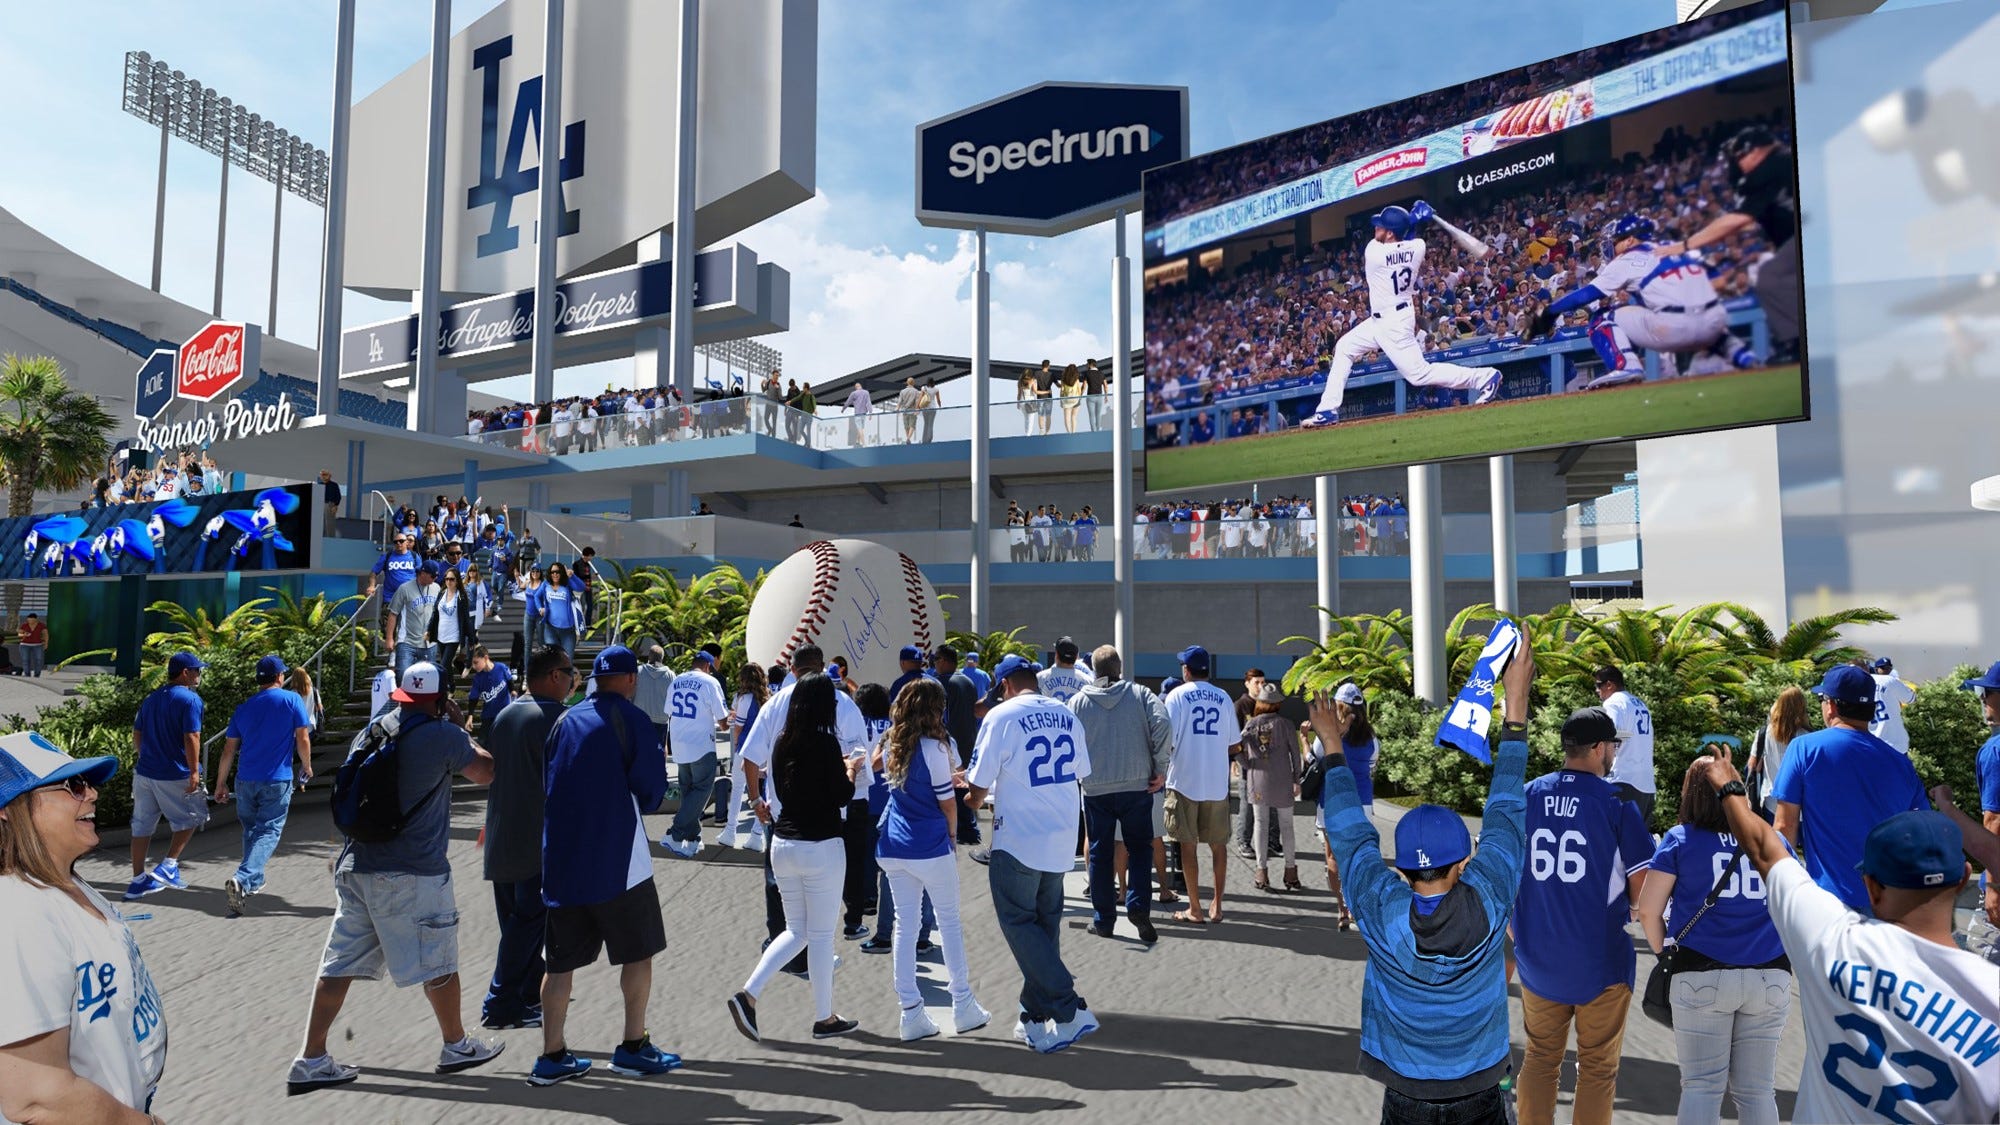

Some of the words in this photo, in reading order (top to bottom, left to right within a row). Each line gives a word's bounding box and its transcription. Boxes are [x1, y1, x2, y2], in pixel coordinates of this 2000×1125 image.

[949, 123, 1150, 184] Spectrum
[1357, 157, 1396, 184] FARMER
[1395, 151, 1425, 167] JOHN
[1474, 152, 1555, 186] CAESARS.COM
[1386, 251, 1415, 266] MUNCY
[1390, 267, 1412, 295] 13
[450, 308, 534, 350] Angeles
[368, 332, 384, 363] LA
[143, 371, 165, 398] ACME
[133, 412, 219, 453] Sponsor
[223, 392, 294, 441] Porch
[388, 561, 414, 571] SOCAL
[1044, 676, 1085, 691] GONZALE
[1184, 690, 1224, 706] KERSHAW
[1018, 711, 1074, 735] KERSHAW
[1191, 706, 1220, 736] 22
[1635, 709, 1650, 735] 27
[1025, 734, 1077, 788] 22
[1544, 795, 1580, 818] PUIG
[1717, 832, 1739, 848] PU
[1416, 849, 1432, 868] LA
[1530, 828, 1587, 884] 66
[1829, 959, 2000, 1068] KERSHAW
[1822, 1012, 1959, 1125] 22
